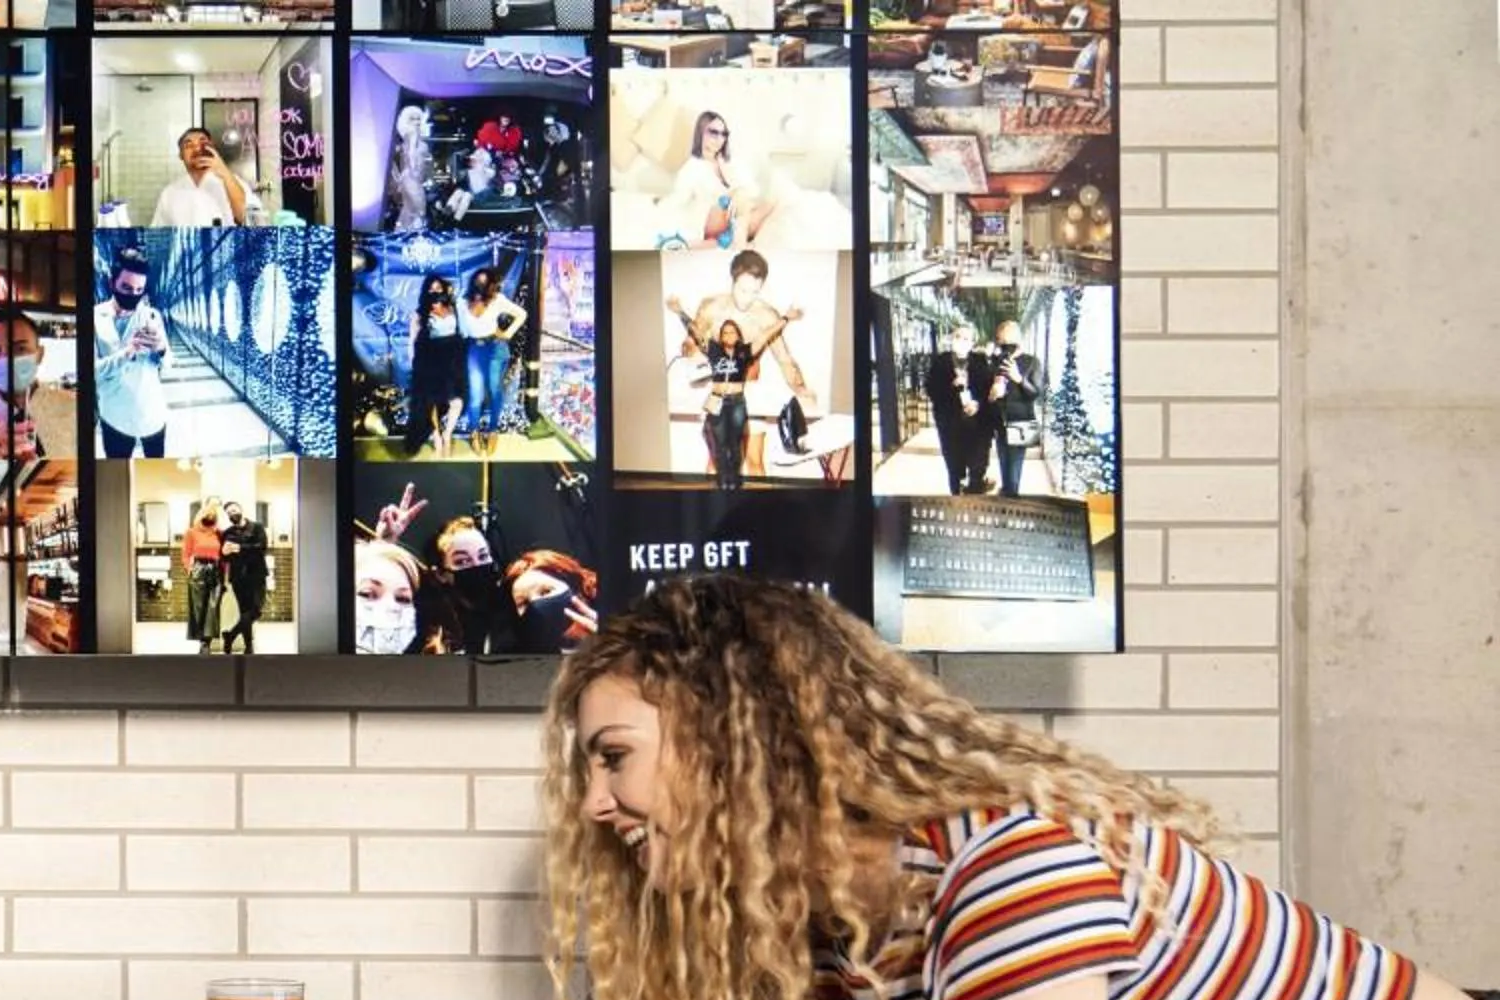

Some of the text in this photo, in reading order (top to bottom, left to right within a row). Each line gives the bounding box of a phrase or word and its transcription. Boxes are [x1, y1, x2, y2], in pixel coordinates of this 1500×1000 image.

[466, 48, 593, 80] mox
[630, 541, 751, 571] KEEP 6FT
